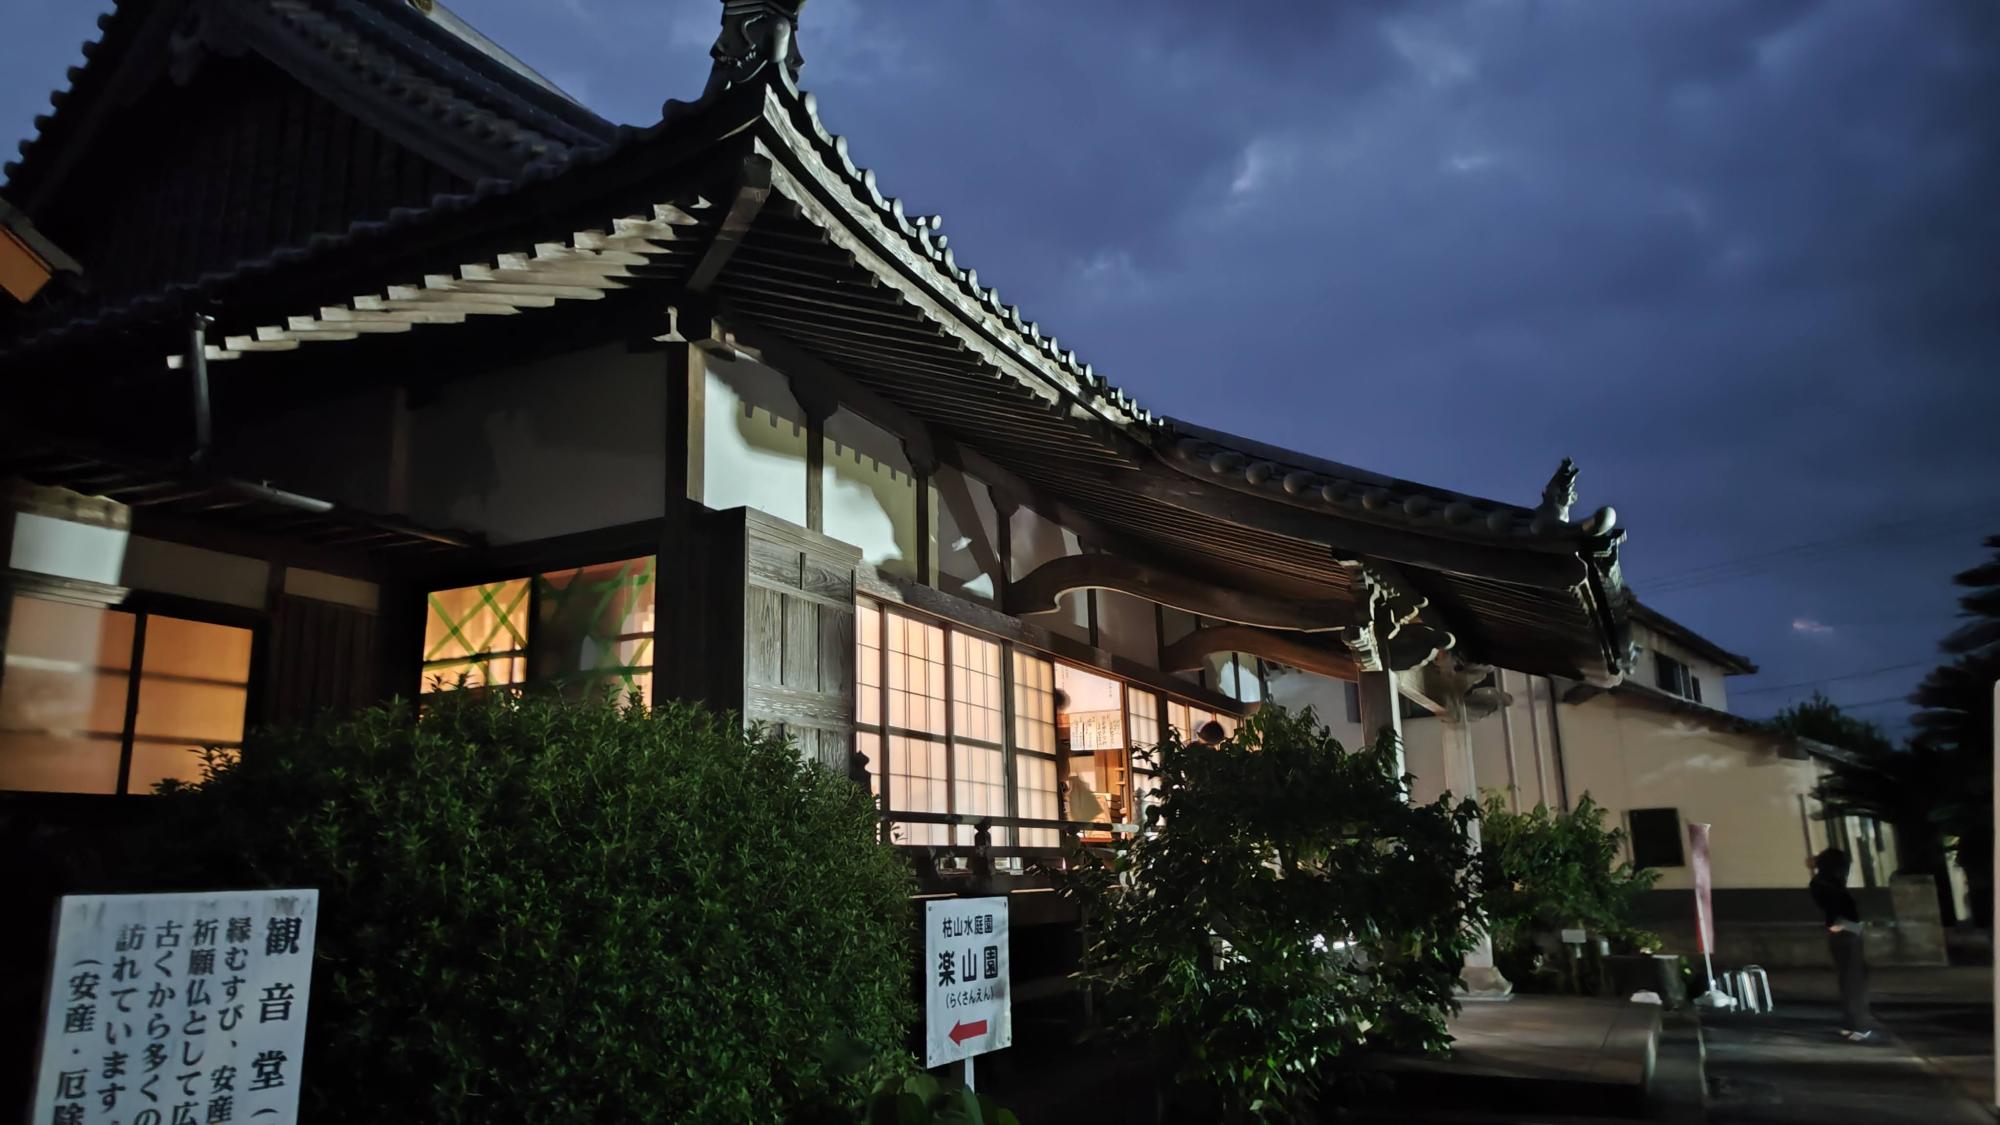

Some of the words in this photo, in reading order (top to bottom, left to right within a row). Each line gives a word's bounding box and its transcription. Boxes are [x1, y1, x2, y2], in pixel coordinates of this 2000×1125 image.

[942, 914, 993, 939] 枯山水庭園
[938, 945, 998, 987] 楽山園
